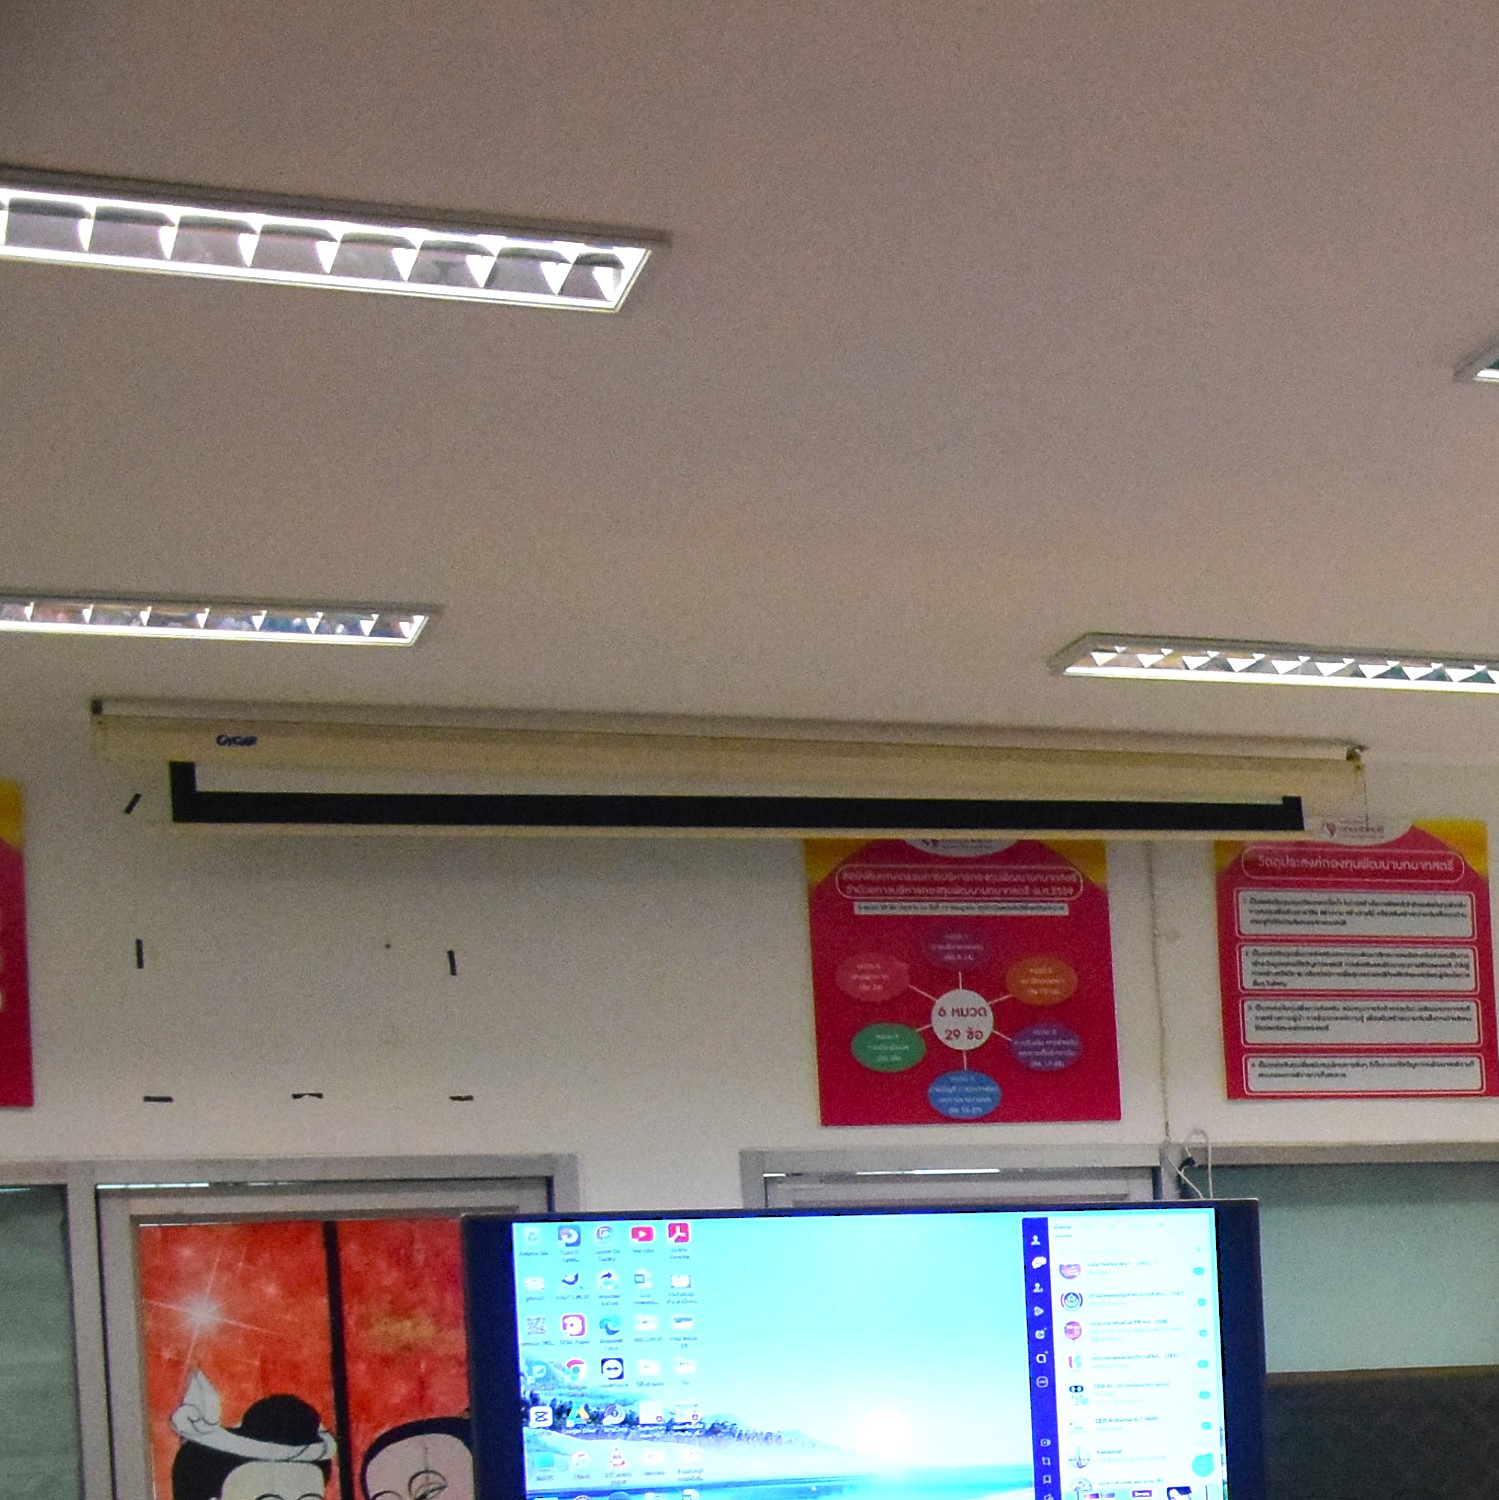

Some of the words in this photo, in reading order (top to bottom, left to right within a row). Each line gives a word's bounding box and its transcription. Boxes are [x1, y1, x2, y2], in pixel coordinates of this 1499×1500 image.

[938, 1006, 948, 1018] 6
[951, 1005, 987, 1018] หมวด
[945, 1028, 961, 1040] 29
